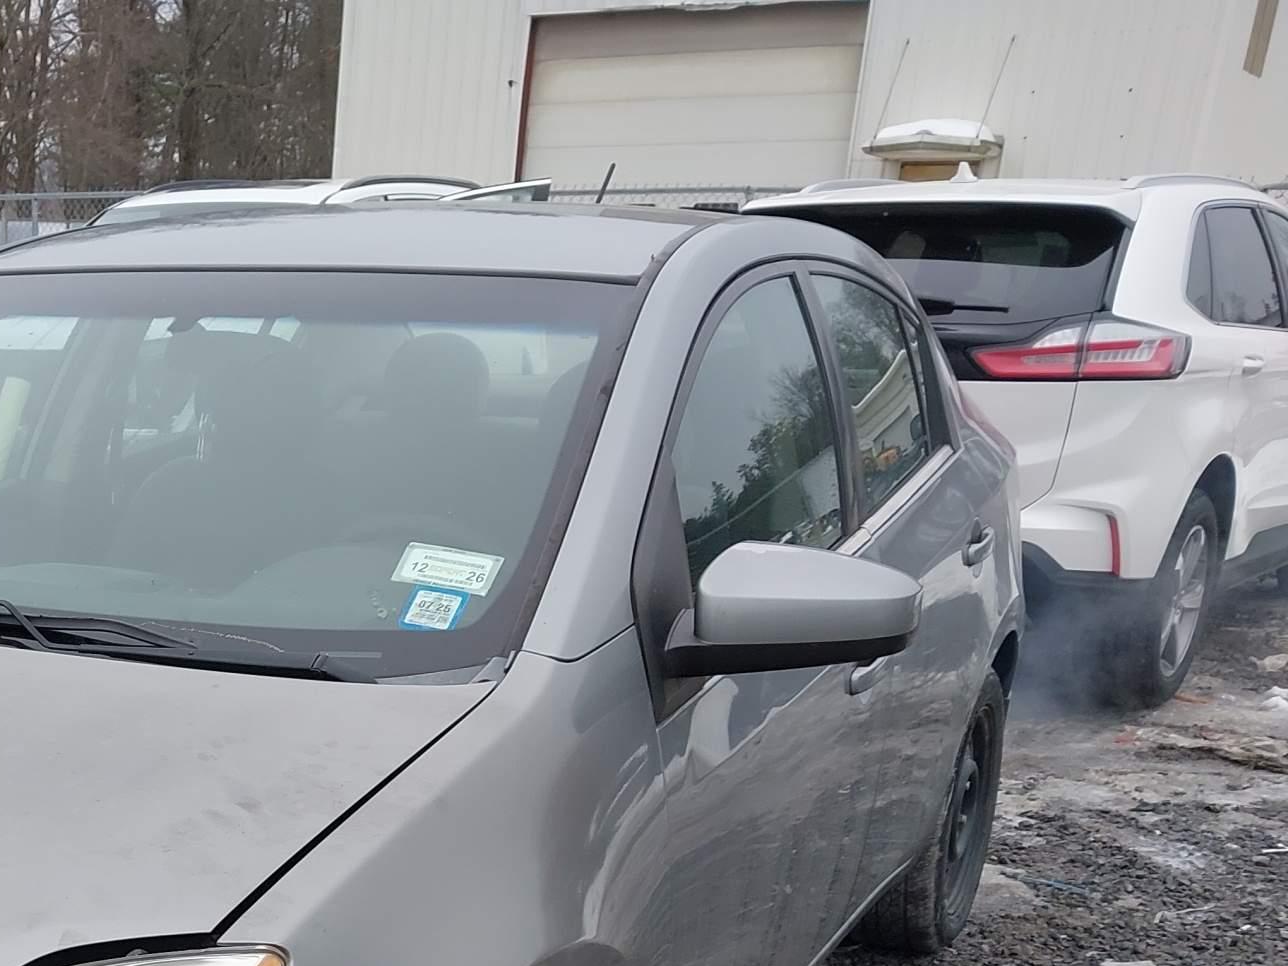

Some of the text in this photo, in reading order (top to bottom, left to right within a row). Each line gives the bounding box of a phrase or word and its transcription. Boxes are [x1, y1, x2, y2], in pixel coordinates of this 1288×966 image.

[411, 561, 429, 573] 12
[465, 571, 486, 583] 26
[436, 602, 452, 613] 25
